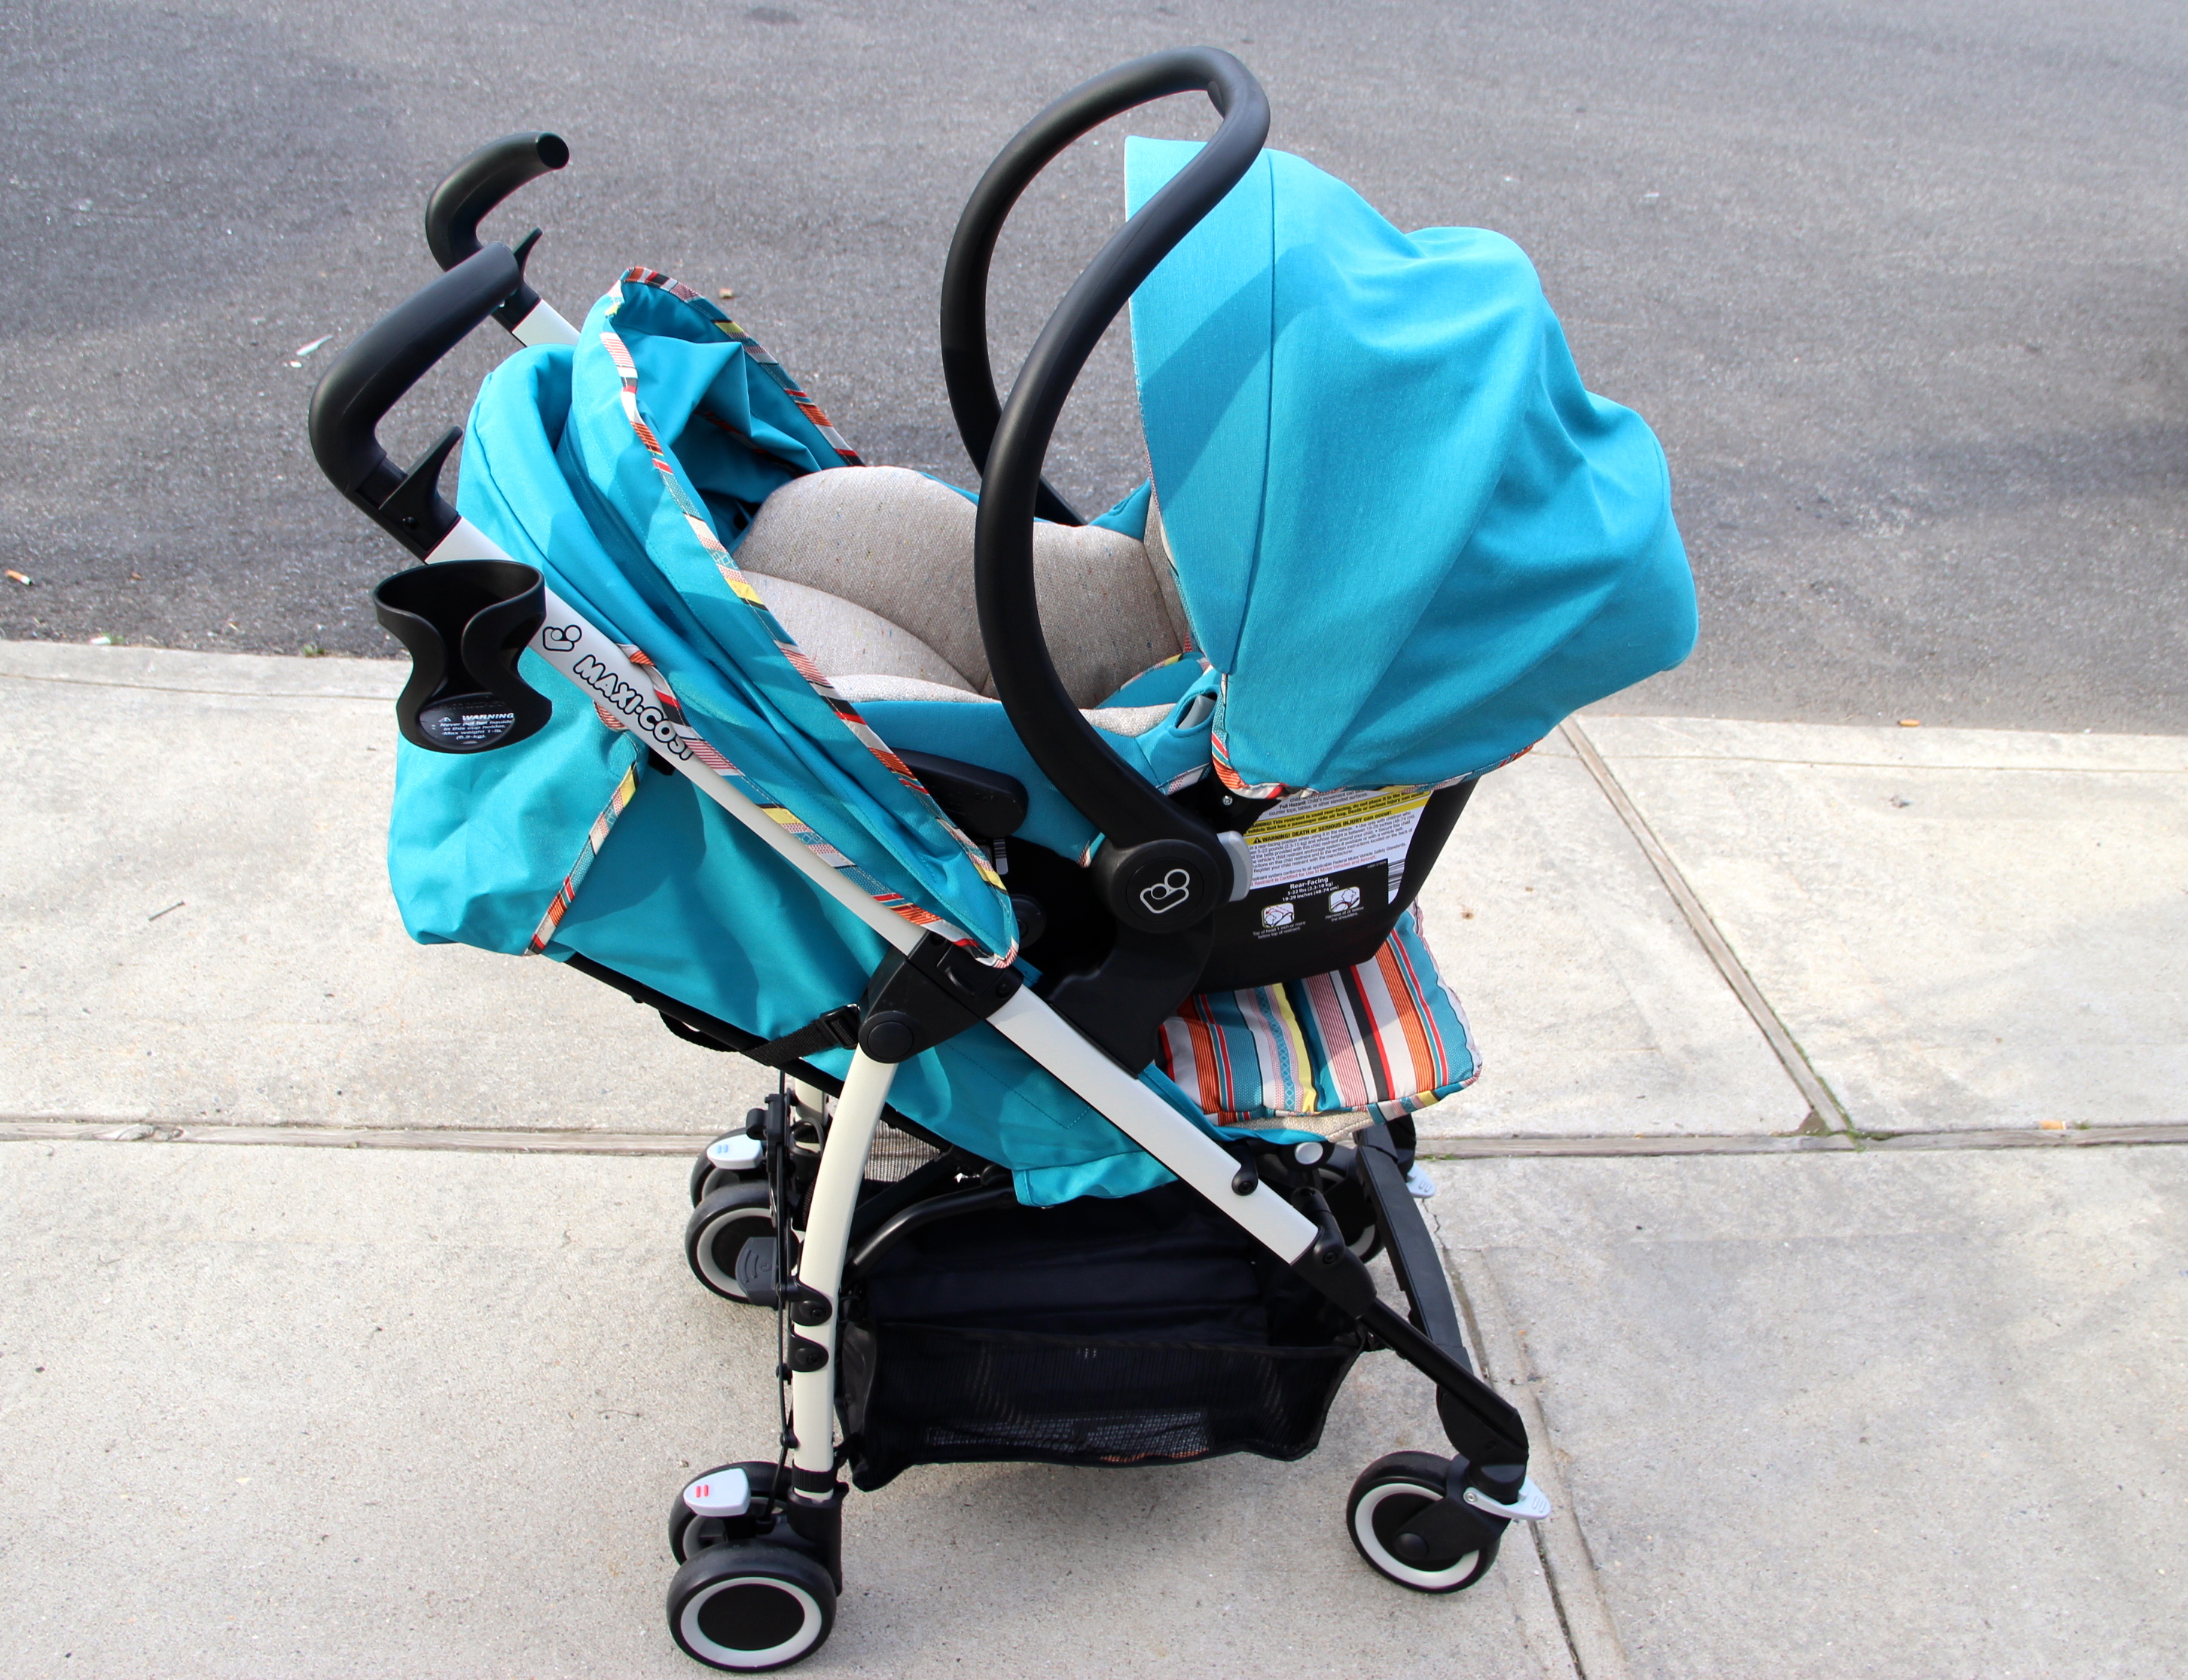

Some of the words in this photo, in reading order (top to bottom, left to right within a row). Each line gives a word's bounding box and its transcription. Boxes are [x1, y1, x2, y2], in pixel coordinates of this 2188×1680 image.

[1262, 833, 1290, 842] WARNING!
[1318, 822, 1341, 831] SERIOUS
[1343, 817, 1362, 826] INJURY
[1290, 877, 1329, 889] Rear-Facing
